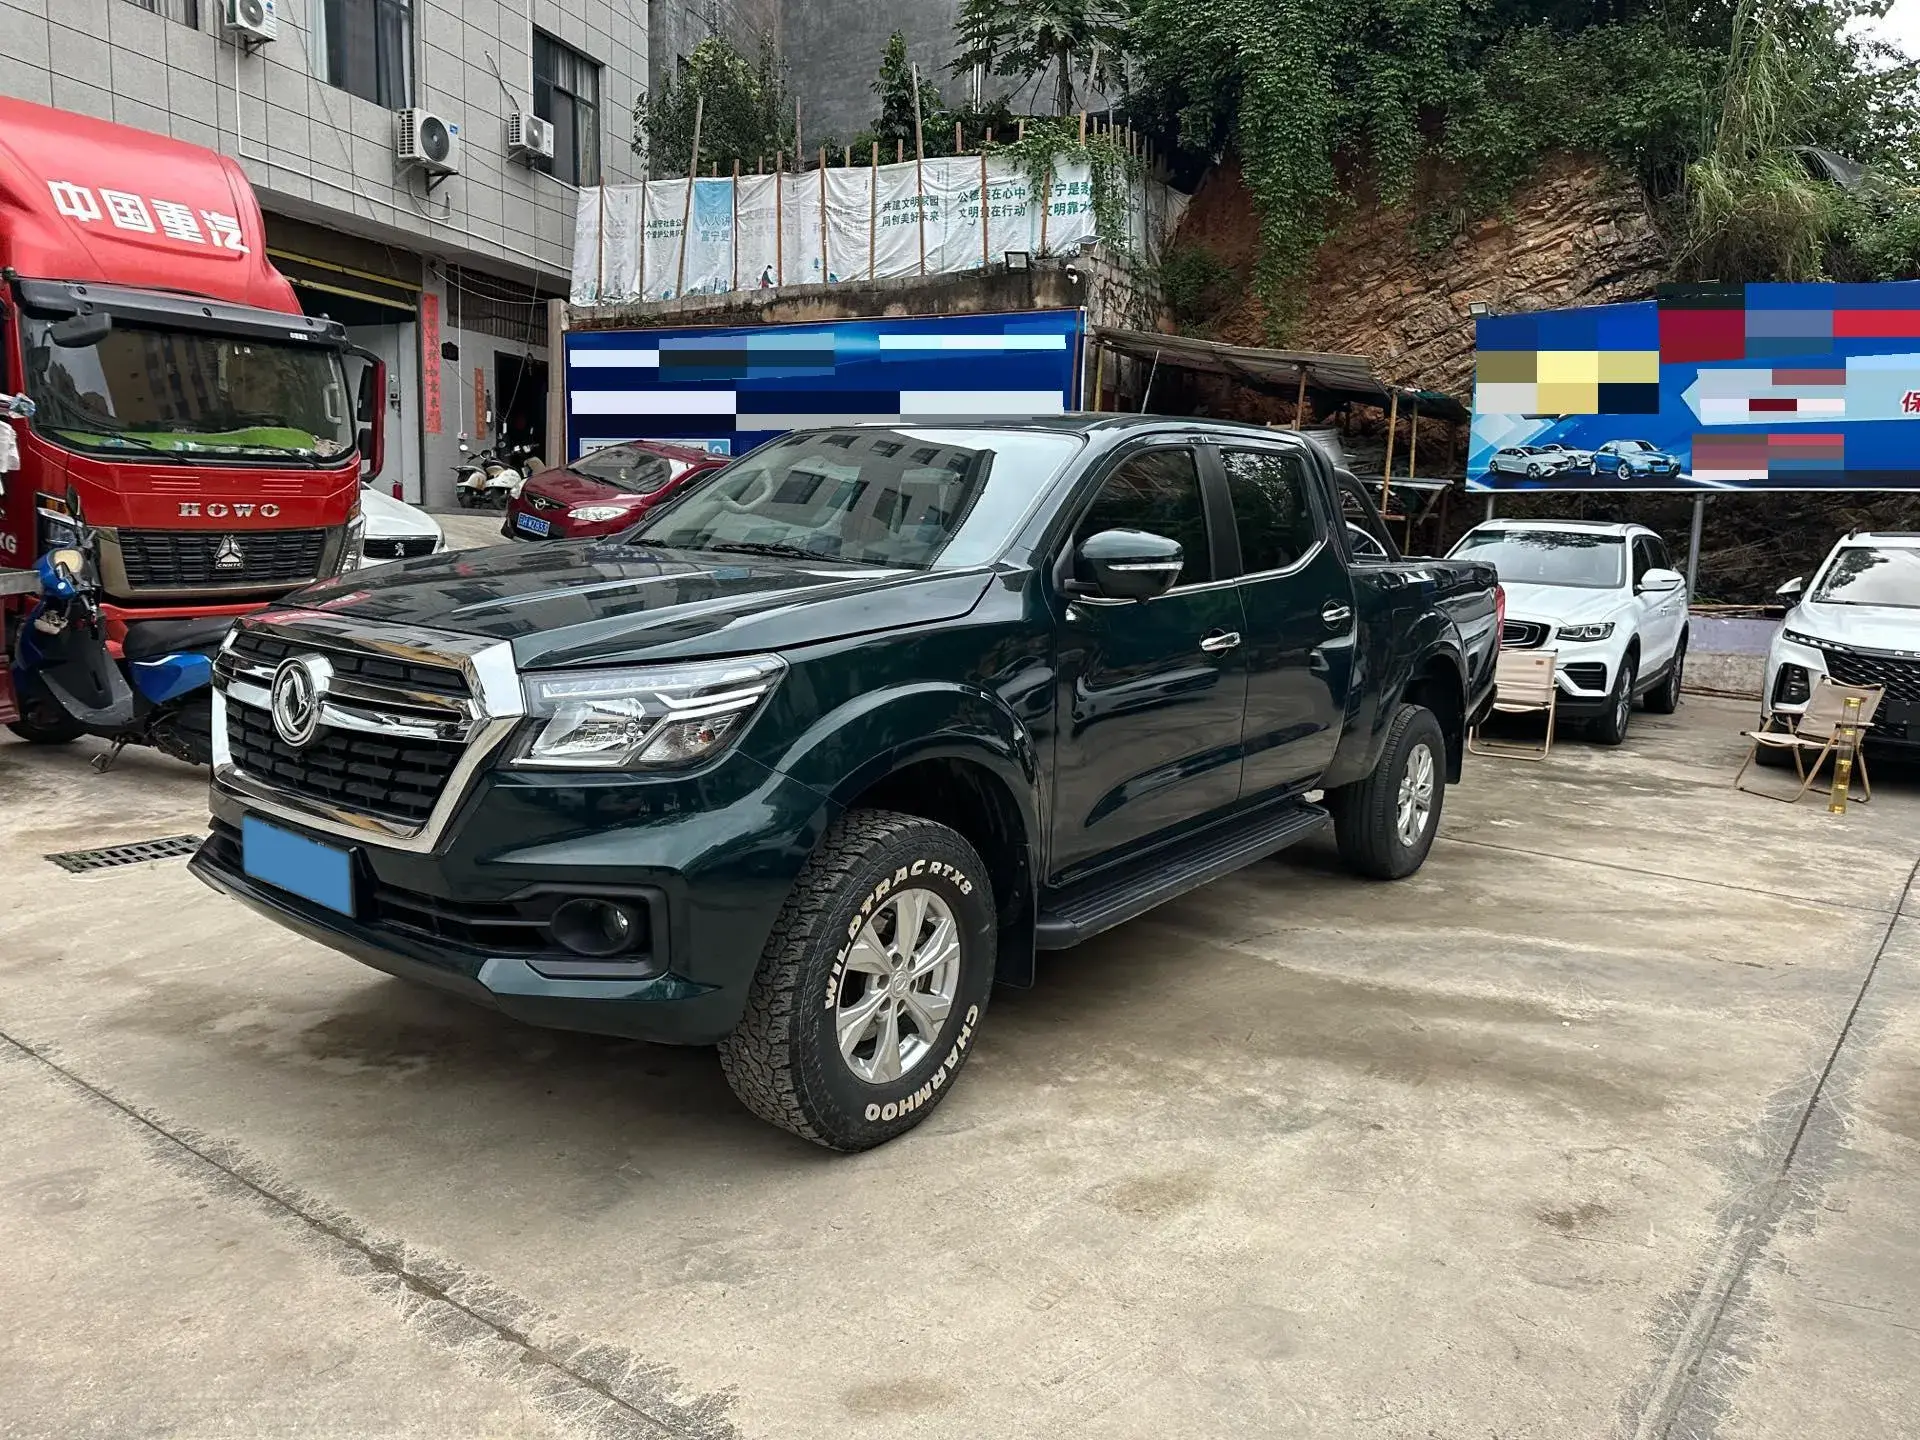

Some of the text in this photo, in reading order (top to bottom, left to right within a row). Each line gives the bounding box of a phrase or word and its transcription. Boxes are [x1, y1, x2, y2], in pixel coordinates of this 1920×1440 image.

[47, 181, 250, 254] 中国重汽
[178, 502, 281, 518] HOWO
[928, 861, 973, 896] RTX8
[864, 1004, 979, 1122] CHARMHOO
